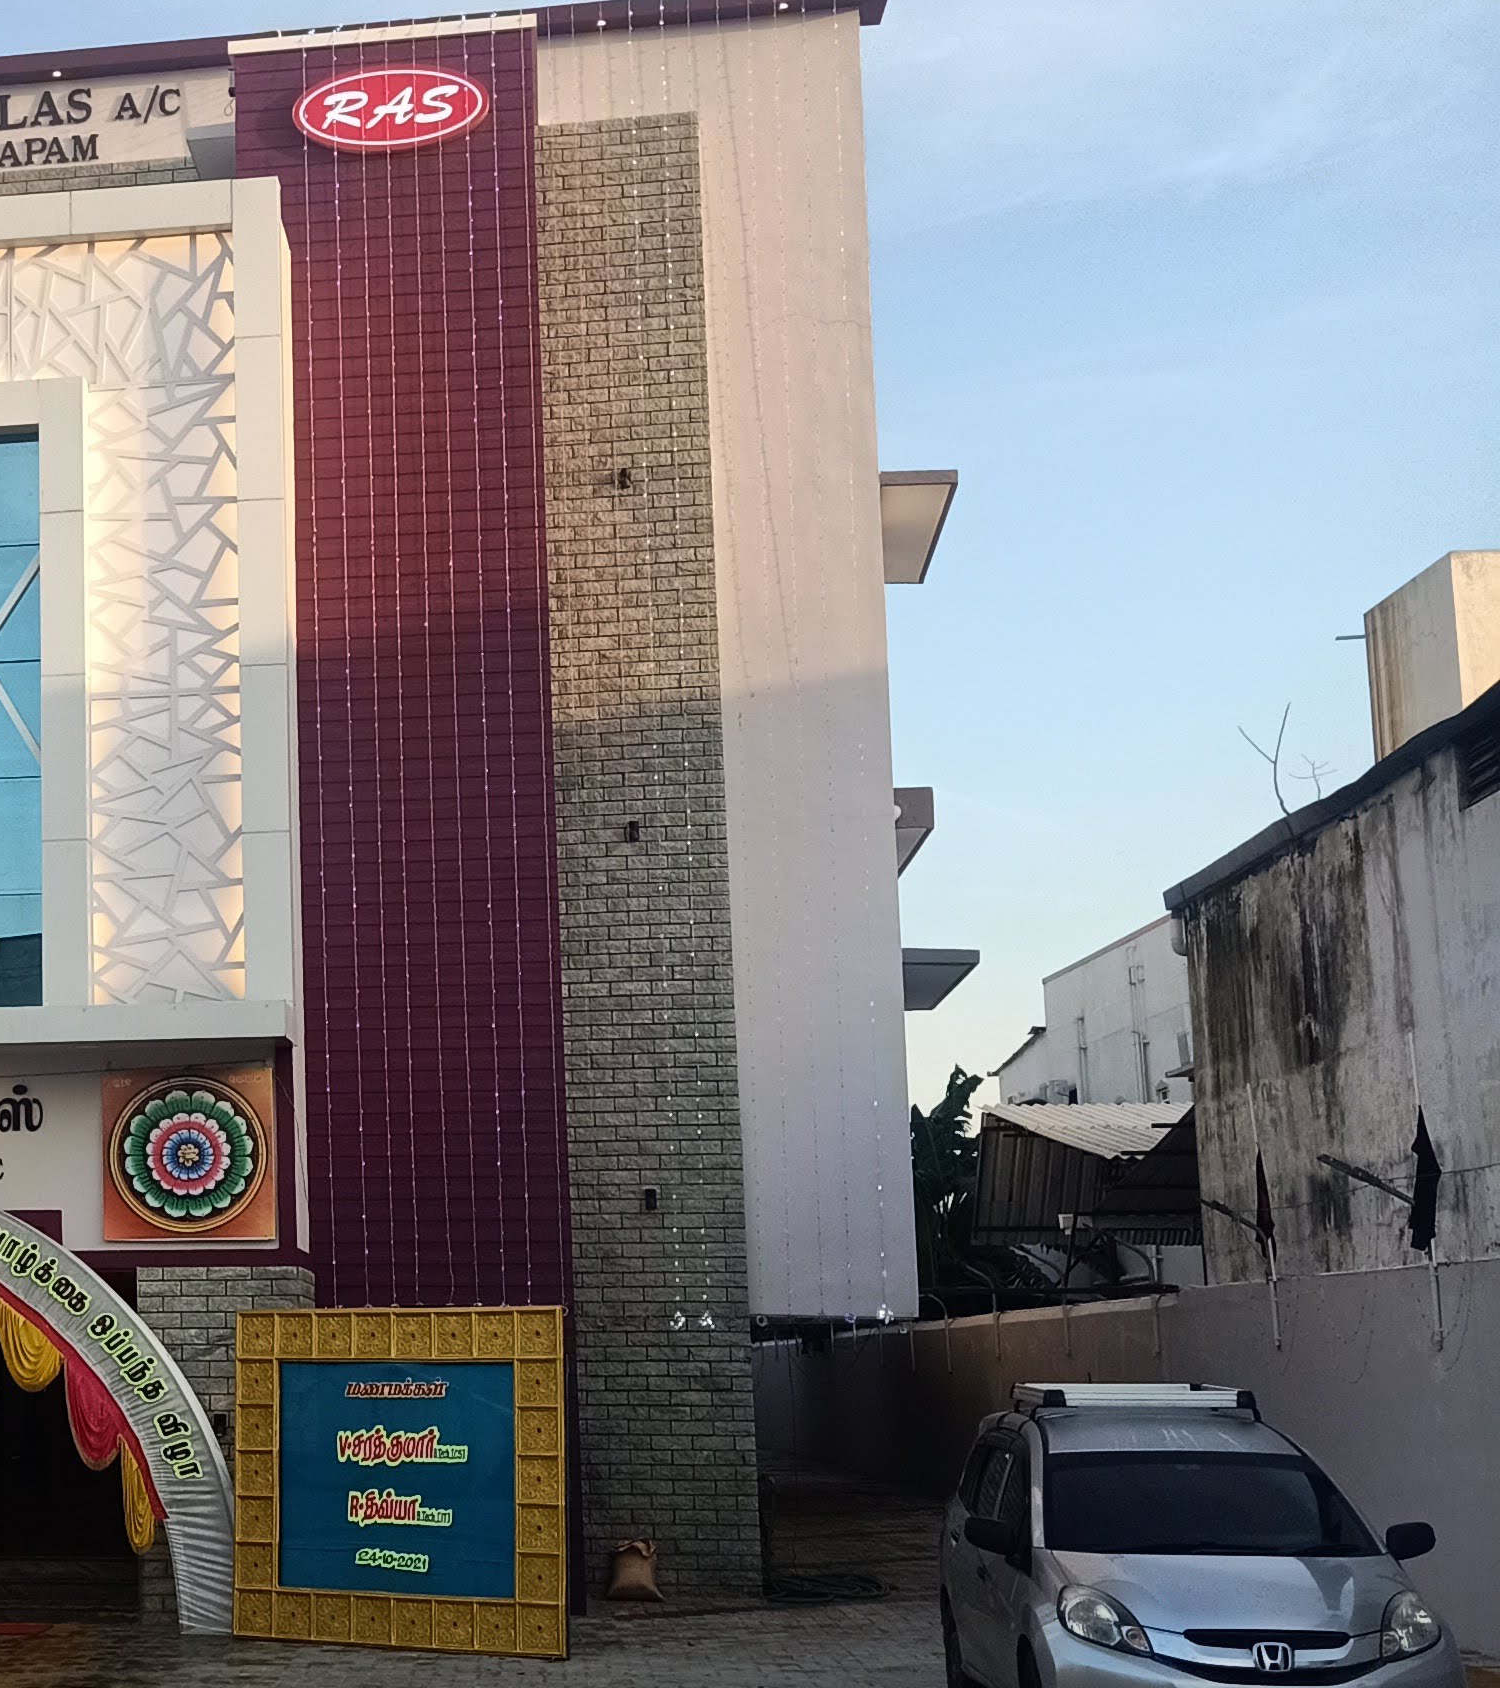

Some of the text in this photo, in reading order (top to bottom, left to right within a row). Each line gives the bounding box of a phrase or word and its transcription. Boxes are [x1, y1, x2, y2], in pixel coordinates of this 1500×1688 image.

[114, 84, 181, 124] A/C
[320, 84, 460, 130] RAS
[89, 1313, 167, 1401] ஒப்பந்த
[155, 1411, 203, 1478] விழா
[345, 1377, 449, 1397] மணமக்கள்
[357, 1550, 427, 1570] 24-10-2021
